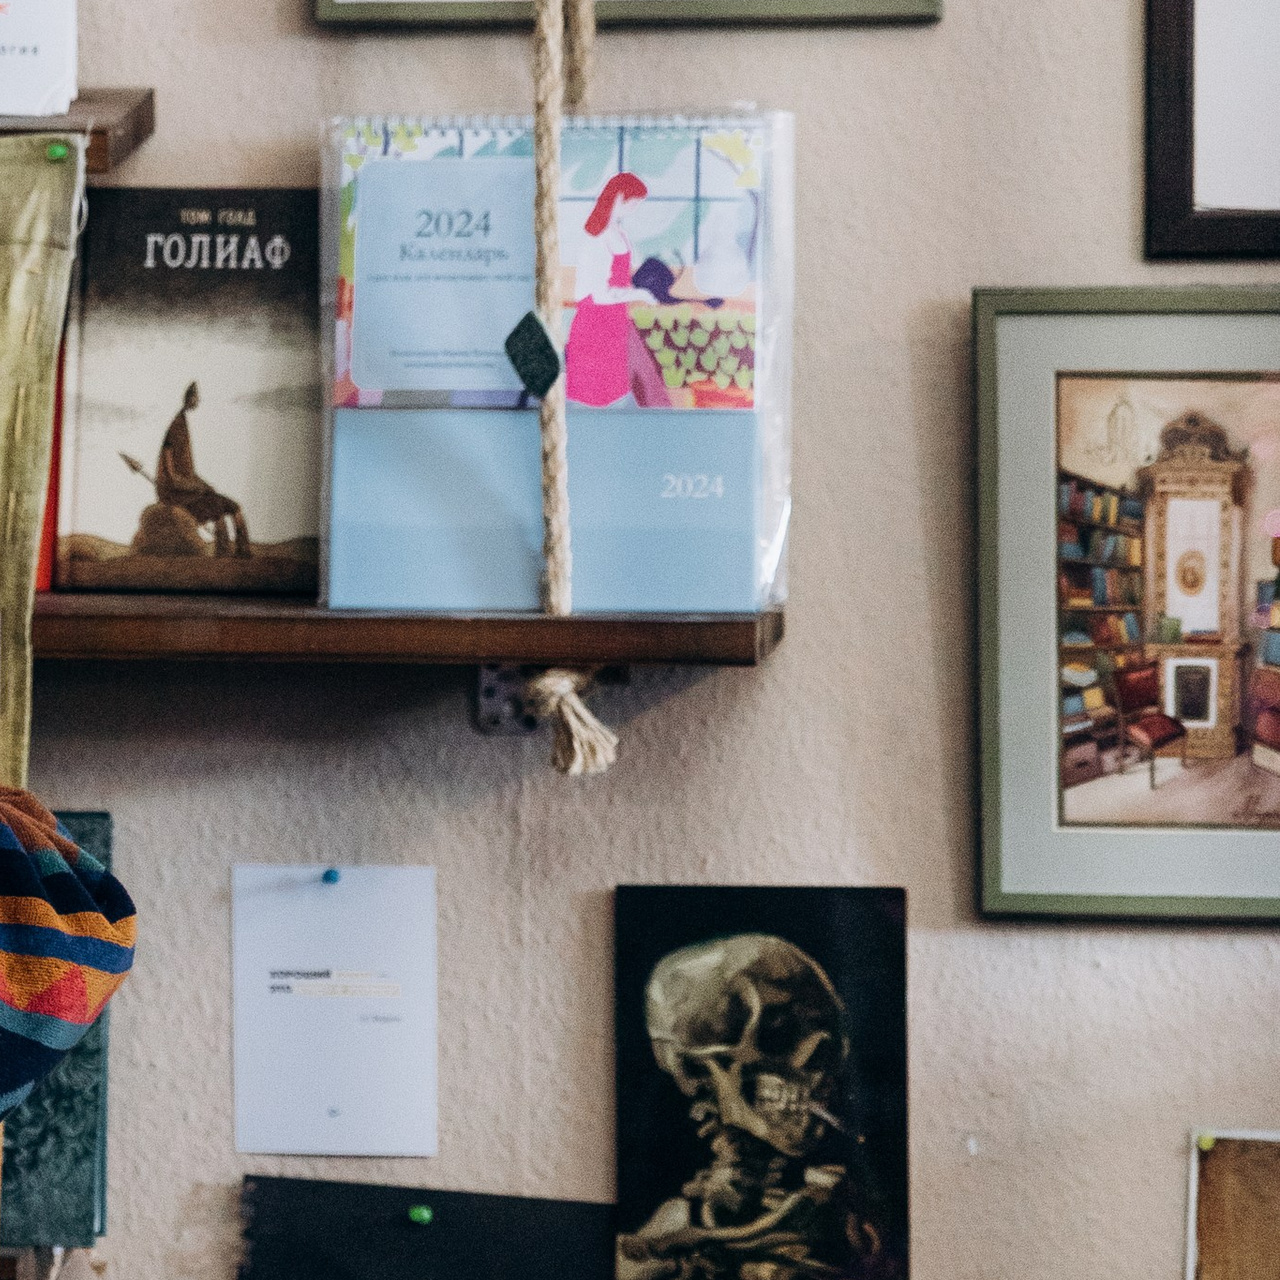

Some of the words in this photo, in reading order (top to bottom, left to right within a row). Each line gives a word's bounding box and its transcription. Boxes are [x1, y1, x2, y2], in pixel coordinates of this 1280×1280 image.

[415, 208, 493, 238] 2024
[144, 233, 292, 269] ГОЛИАФ
[660, 472, 725, 499] 2024
